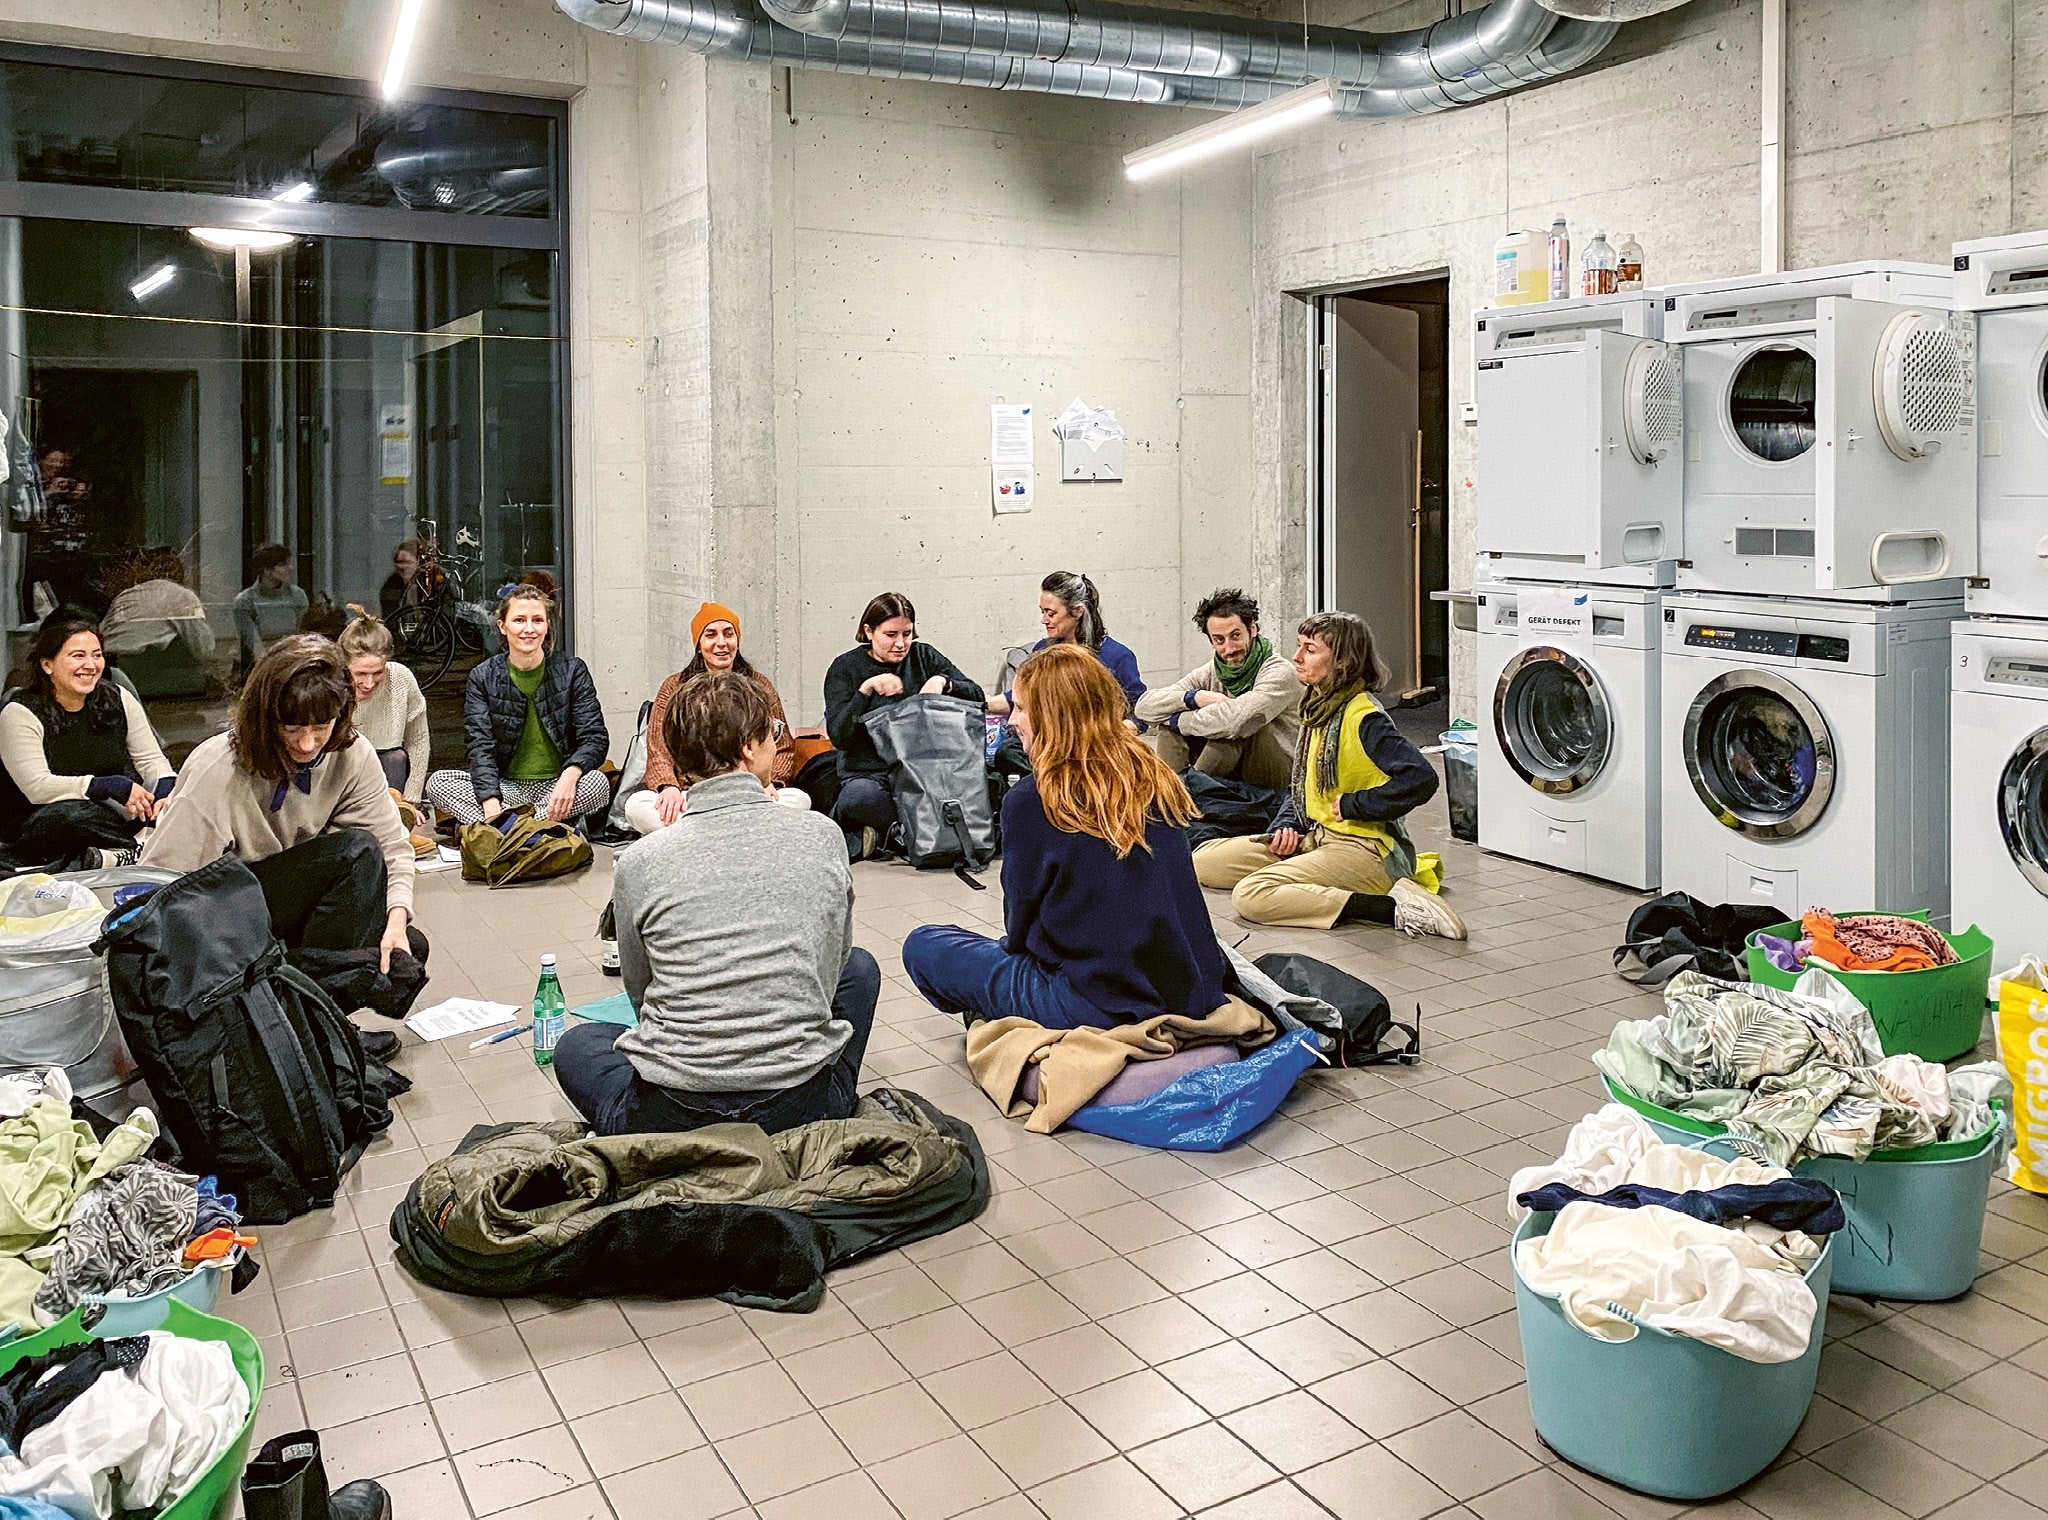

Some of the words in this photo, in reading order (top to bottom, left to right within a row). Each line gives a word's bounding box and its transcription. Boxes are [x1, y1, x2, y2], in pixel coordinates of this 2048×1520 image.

[1958, 257, 1966, 270] 3
[1666, 300, 1674, 311] 2
[1528, 616, 1551, 625] GERÄT
[1552, 618, 1582, 626] DEFEKT
[1666, 610, 1673, 622] 2
[1960, 655, 1969, 668] 3
